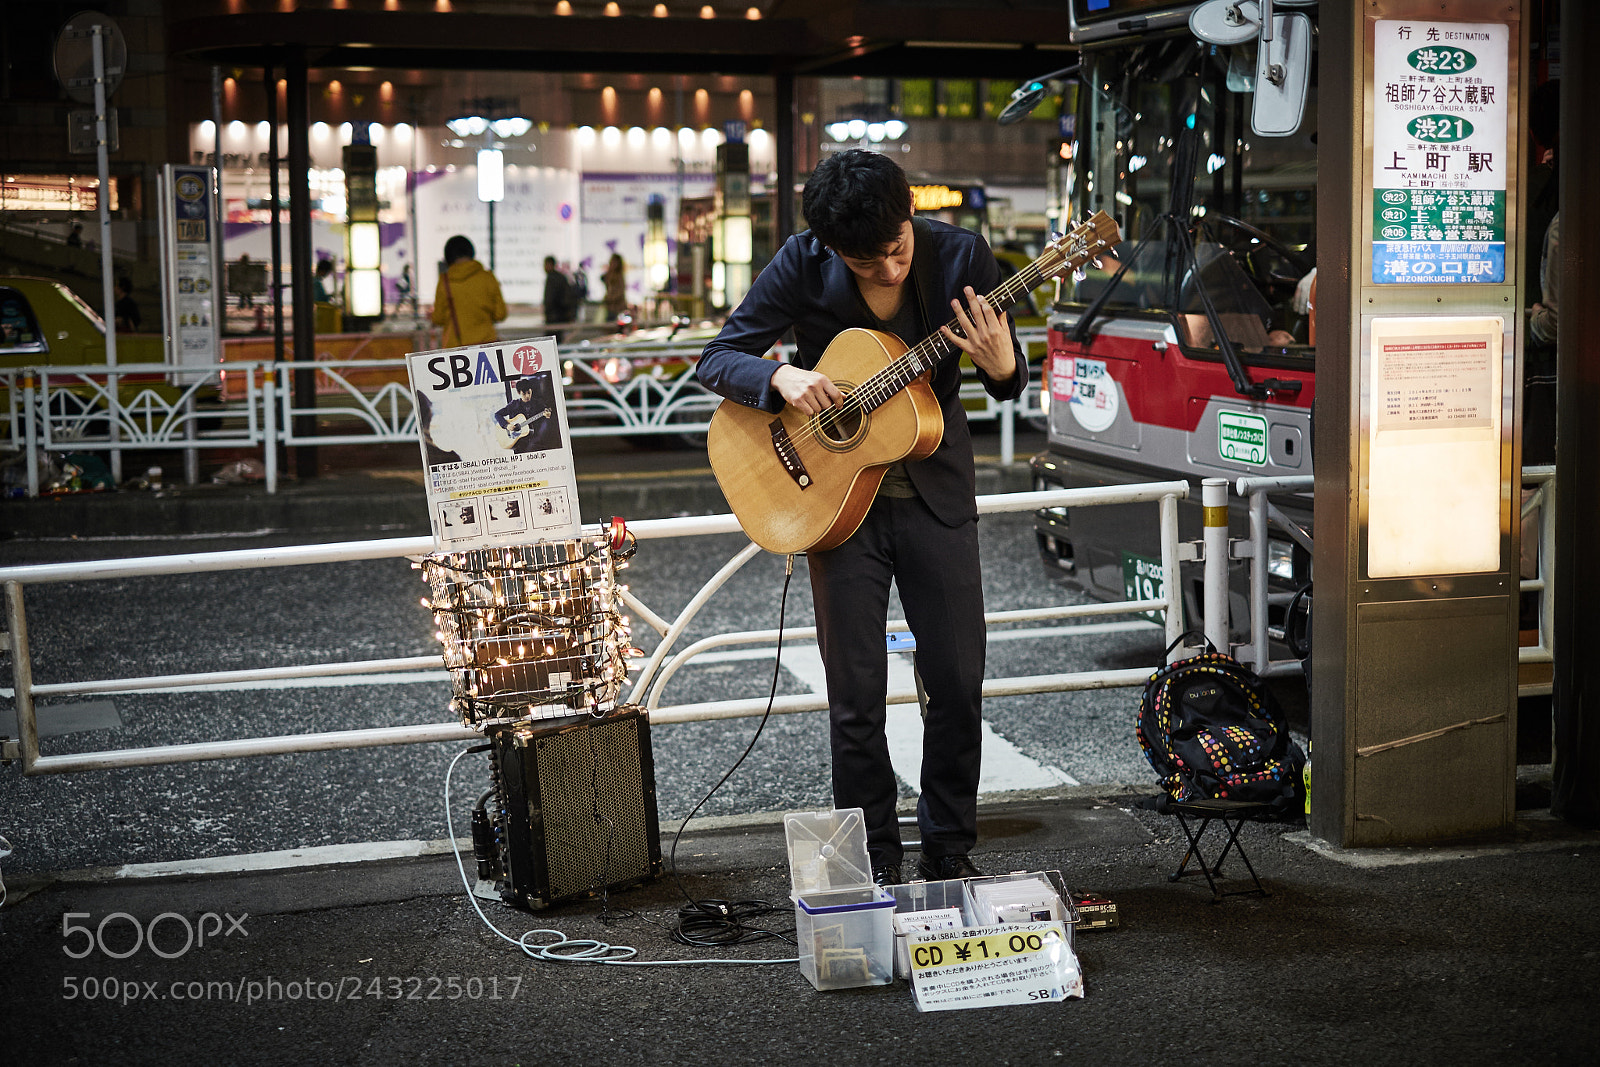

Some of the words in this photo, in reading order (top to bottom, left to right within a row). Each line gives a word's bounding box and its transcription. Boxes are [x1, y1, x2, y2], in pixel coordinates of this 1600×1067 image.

[1398, 26, 1440, 41] 行先
[1445, 32, 1490, 41] DESTINATION
[1416, 50, 1466, 70] 渋23
[1414, 118, 1463, 139] 渋21
[1384, 152, 1493, 172] 上町駅
[1403, 180, 1436, 188] 上町
[1385, 211, 1404, 219] 渋21
[180, 222, 205, 238] TAXI
[1384, 260, 1493, 275] 溝の口駅
[428, 349, 522, 390] SBAL
[482, 456, 509, 466] OFFICIAL
[915, 945, 943, 966] CD
[1028, 985, 1070, 1000] SBAL
